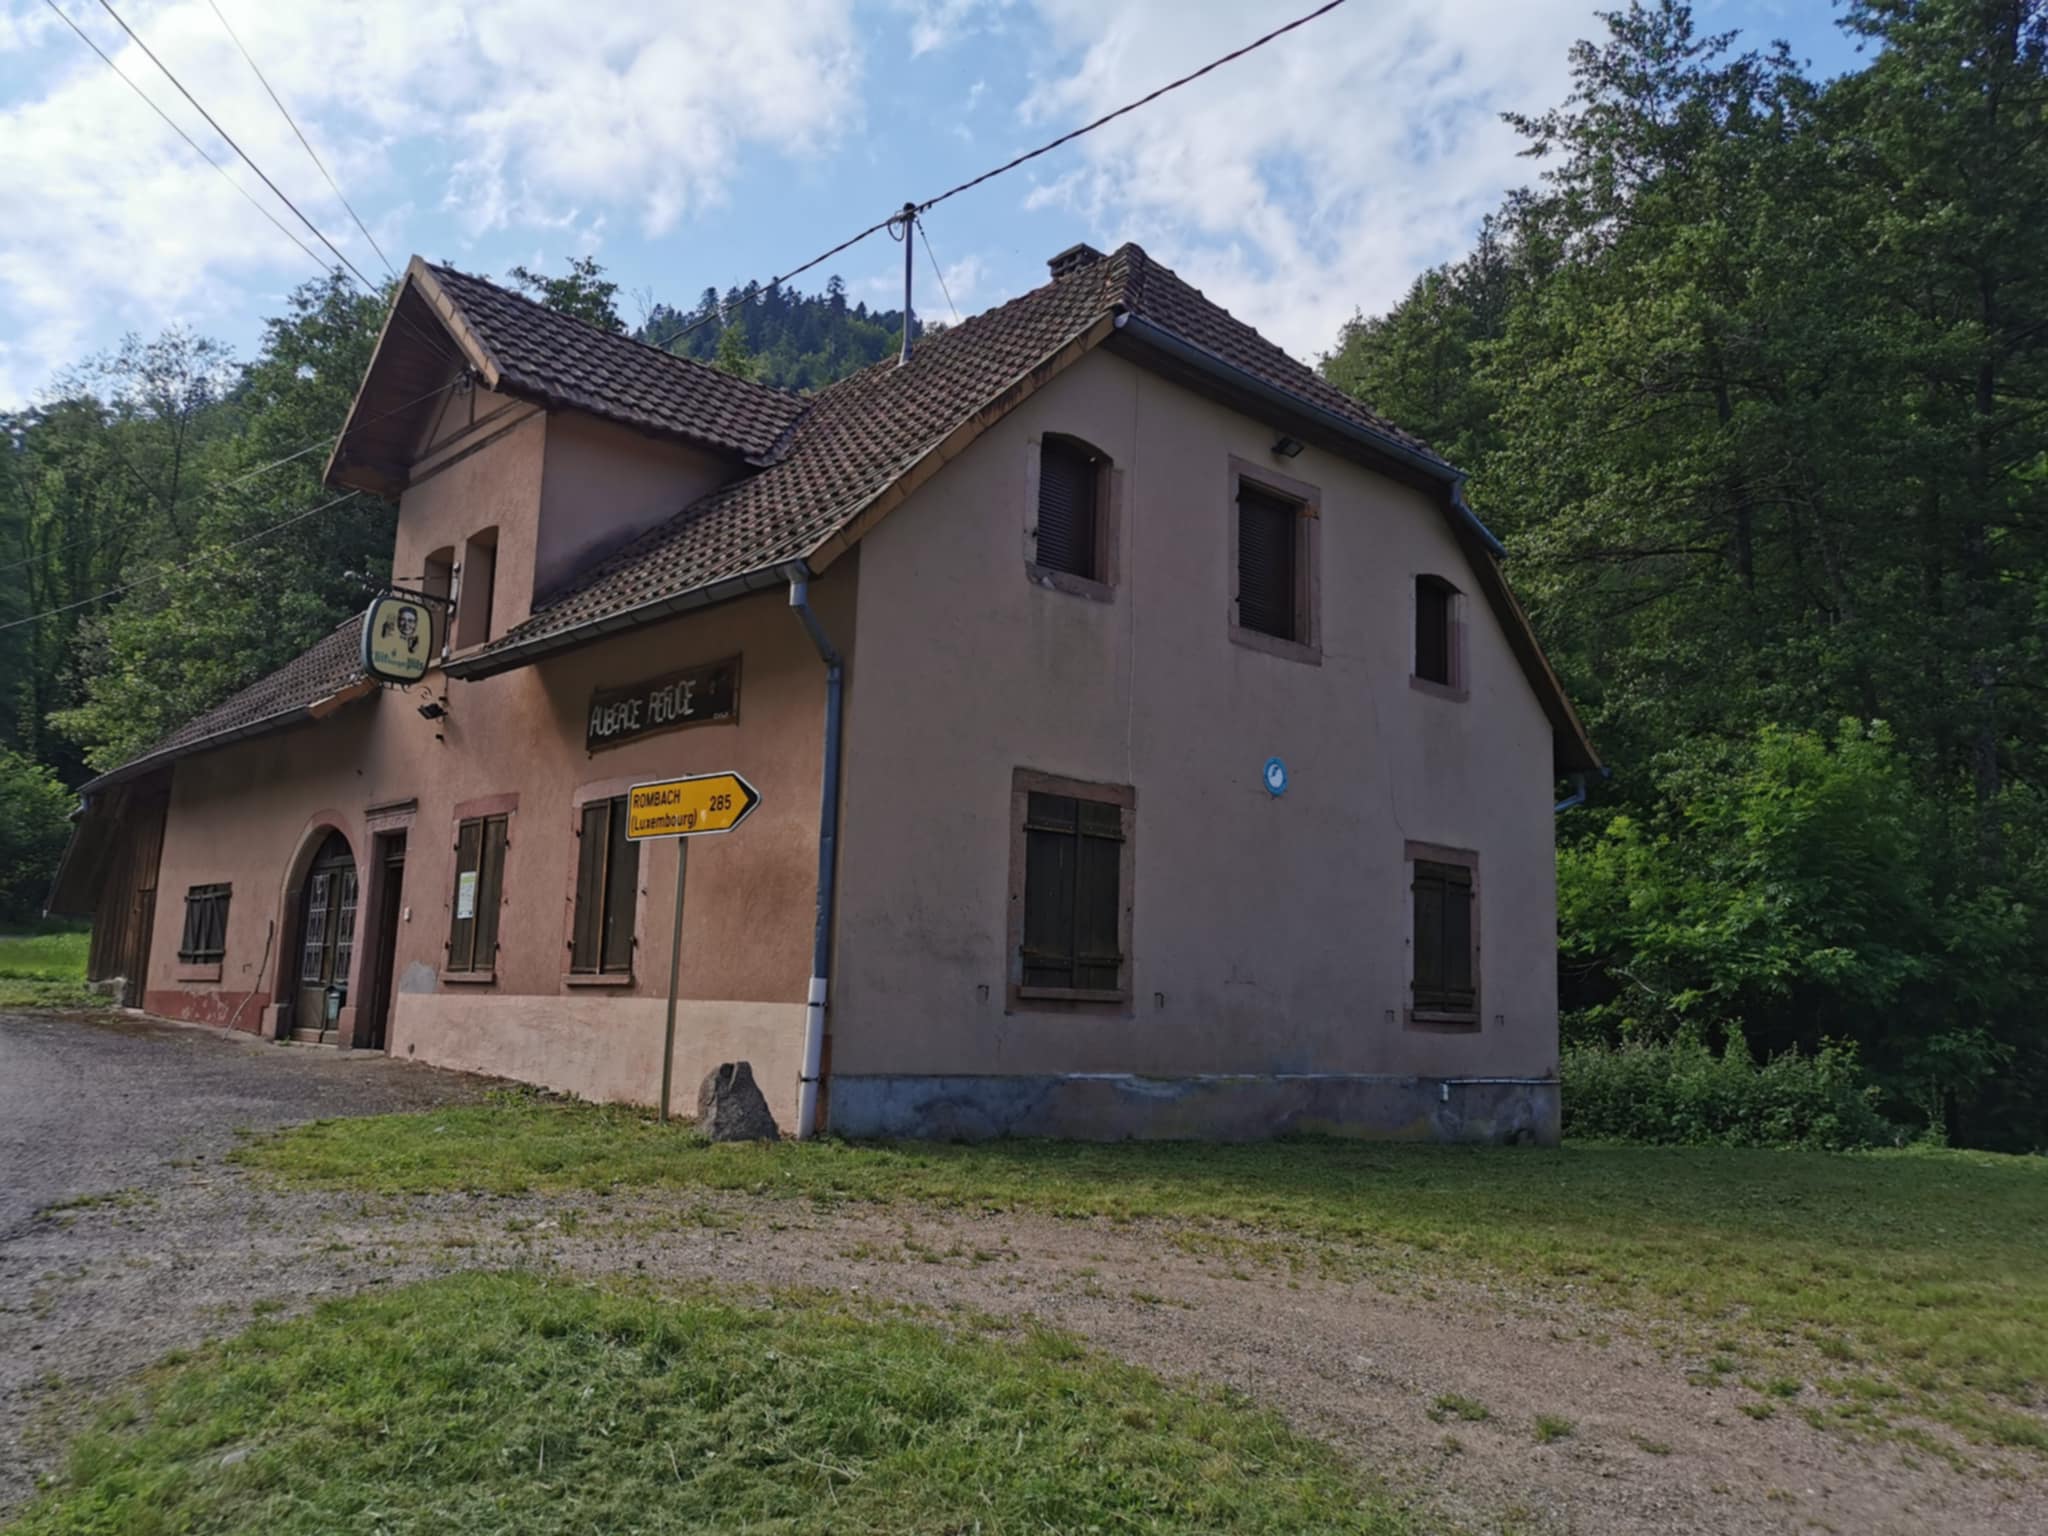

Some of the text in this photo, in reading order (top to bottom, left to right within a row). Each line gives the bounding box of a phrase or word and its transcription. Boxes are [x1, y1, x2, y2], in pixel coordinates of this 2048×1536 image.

[633, 788, 681, 809] ROMBACH
[709, 794, 732, 812] 285
[631, 808, 698, 833] (Luxembourg)
